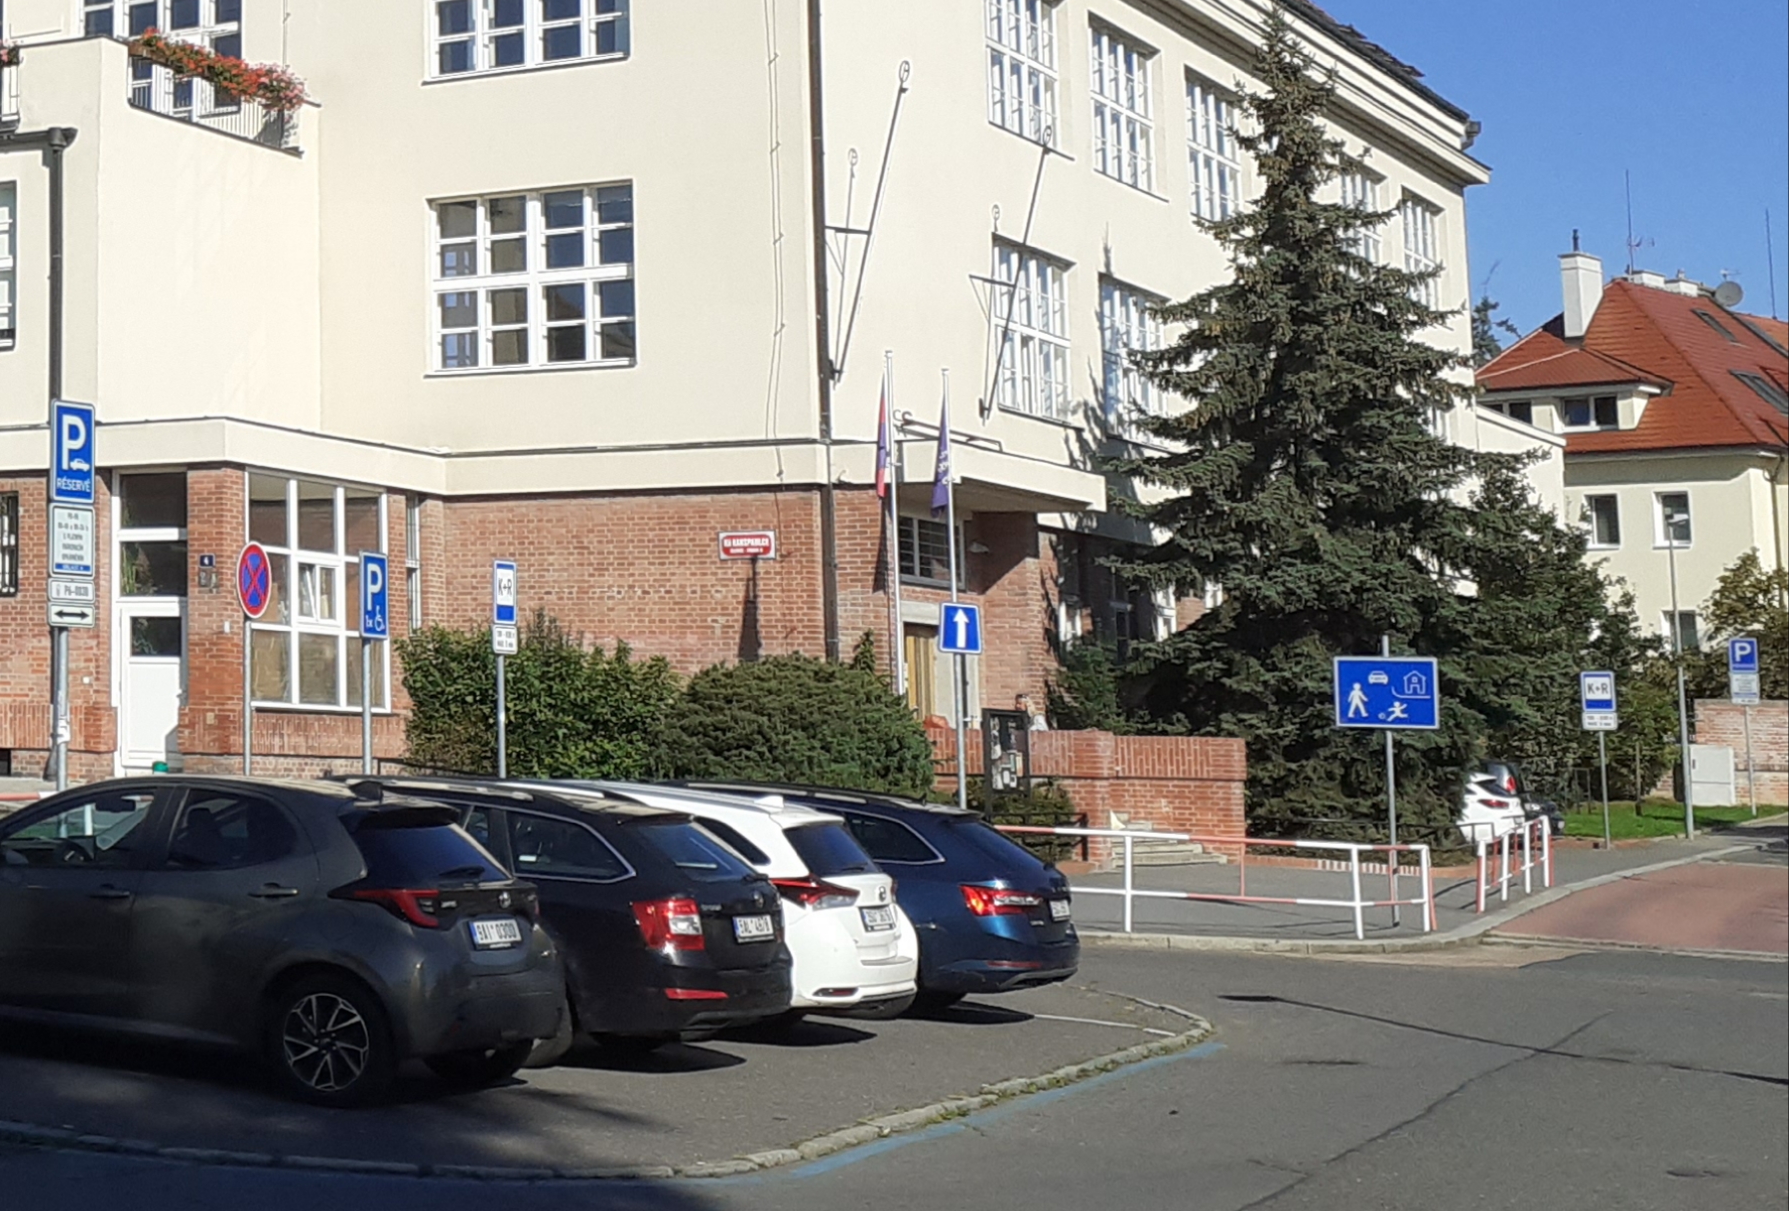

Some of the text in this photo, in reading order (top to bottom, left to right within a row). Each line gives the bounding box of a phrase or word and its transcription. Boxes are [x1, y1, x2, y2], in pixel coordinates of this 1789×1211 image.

[62, 414, 86, 470] P
[57, 476, 91, 493] RÉSERVÉ
[367, 563, 382, 611] P
[498, 578, 513, 597] K+R
[1734, 642, 1751, 662] P
[1587, 682, 1609, 695] K+R
